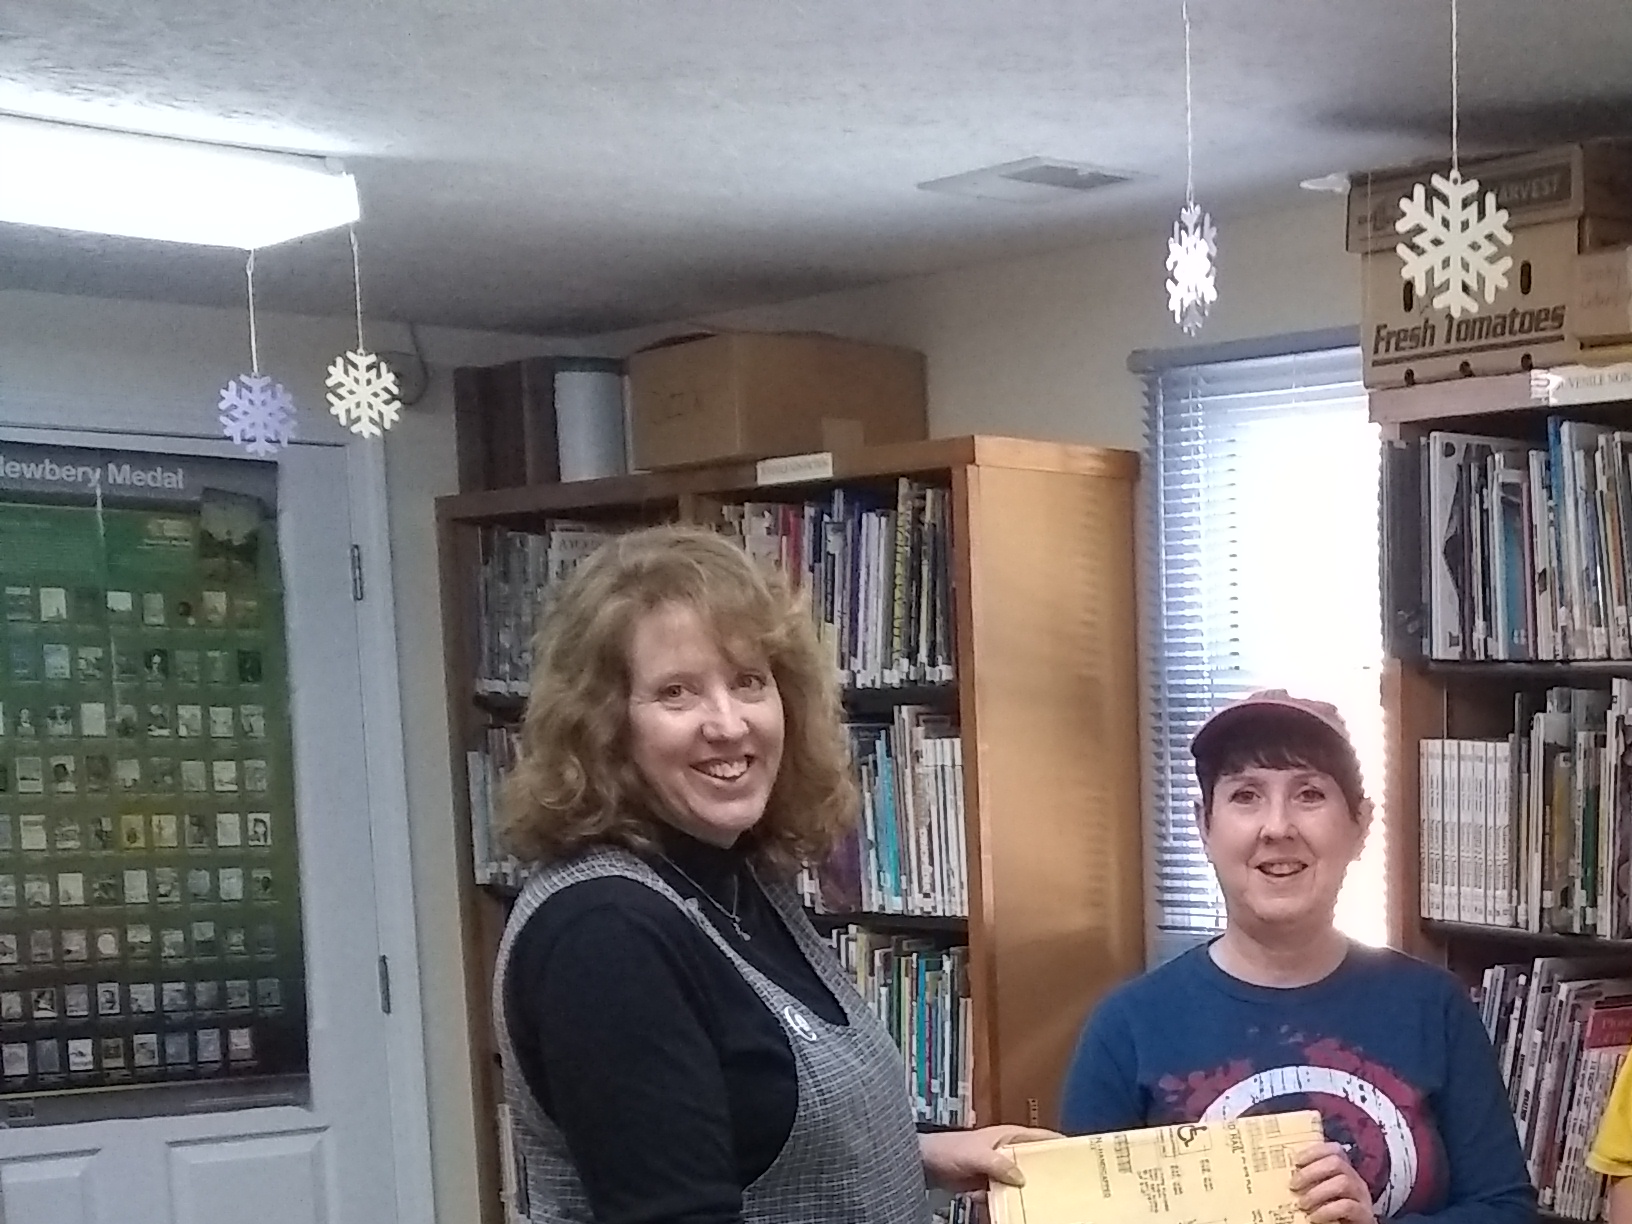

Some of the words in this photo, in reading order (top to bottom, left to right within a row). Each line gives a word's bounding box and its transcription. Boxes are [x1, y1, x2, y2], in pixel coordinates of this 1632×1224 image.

[1496, 174, 1559, 202] ARVEST
[1374, 317, 1436, 355] Fresh
[1443, 305, 1566, 347] Tomatoes
[107, 462, 184, 489] Medal
